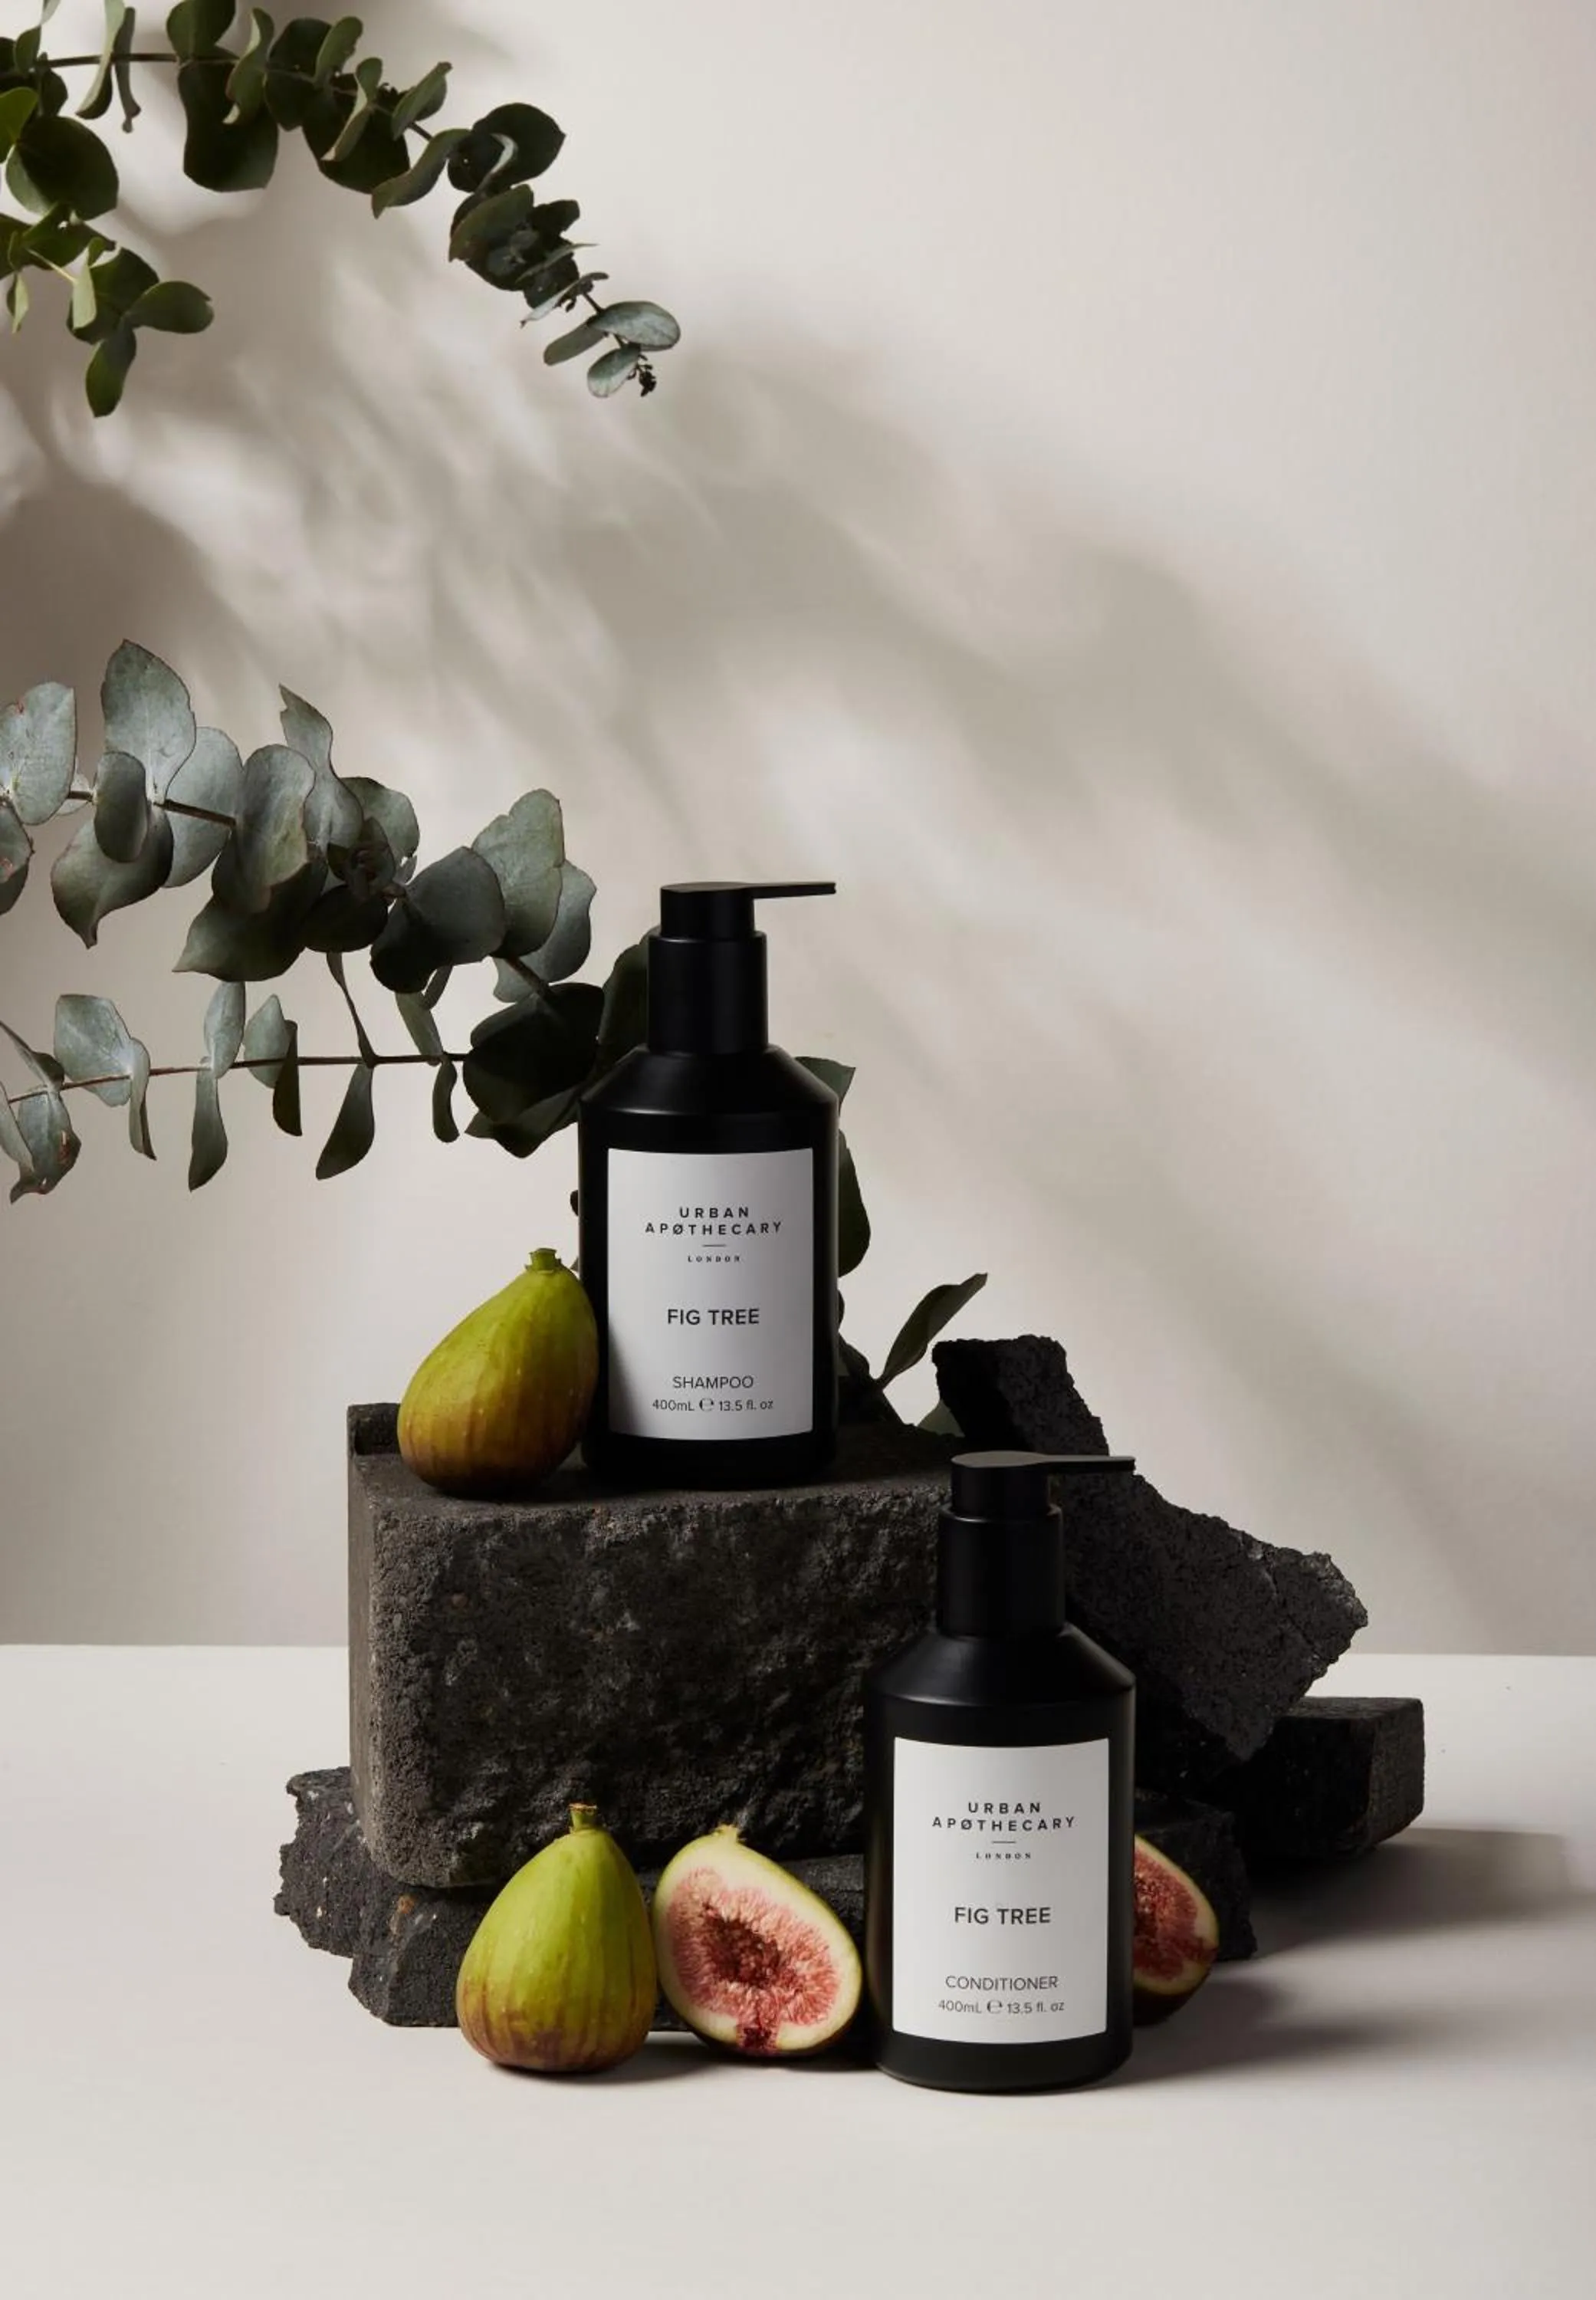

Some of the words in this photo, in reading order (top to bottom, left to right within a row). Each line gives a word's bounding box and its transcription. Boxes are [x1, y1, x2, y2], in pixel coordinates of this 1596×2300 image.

[678, 1206, 750, 1218] URBAN
[667, 1308, 701, 1326] FIG
[708, 1308, 760, 1326] TREE
[672, 1375, 754, 1389] SHAMPOO
[652, 1399, 695, 1411] 400mL
[719, 1400, 743, 1411] 13.5
[745, 1399, 757, 1411] fl.
[760, 1400, 773, 1411] oz
[967, 1802, 1041, 1815] URBAN
[954, 1907, 989, 1925] FIG
[997, 1907, 1051, 1925] TREE
[945, 1975, 1059, 1991] CONDITIONER
[938, 1999, 982, 2013] 400mL
[1007, 2003, 1033, 2014] 13.5
[1036, 2001, 1046, 2013] fl.
[1050, 2001, 1065, 2013] oz
